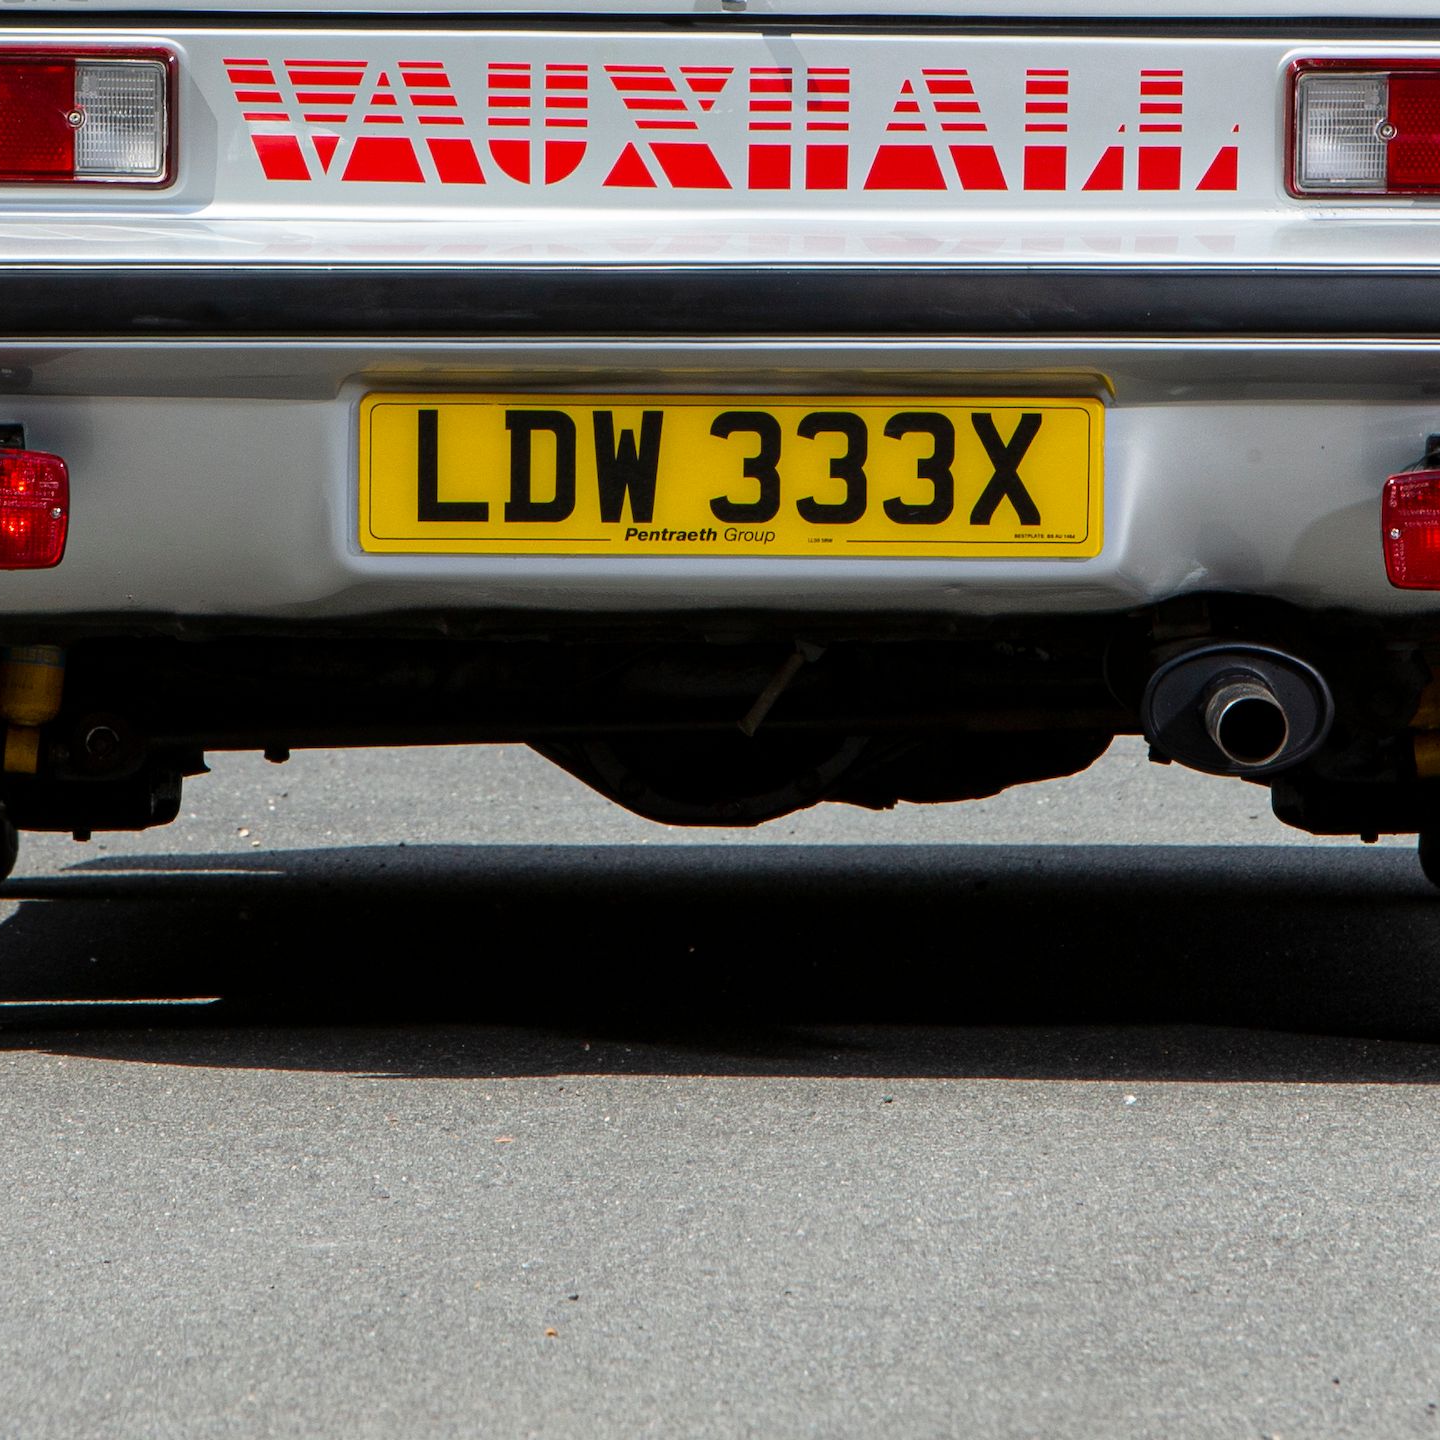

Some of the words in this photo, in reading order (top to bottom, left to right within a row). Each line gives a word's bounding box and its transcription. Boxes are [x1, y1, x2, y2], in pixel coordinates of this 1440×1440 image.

[222, 58, 1240, 192] VAUXHALL
[417, 409, 664, 523] LDW
[709, 410, 1042, 526] 333X
[624, 527, 718, 542] Pentraeth
[724, 527, 776, 544] Group
